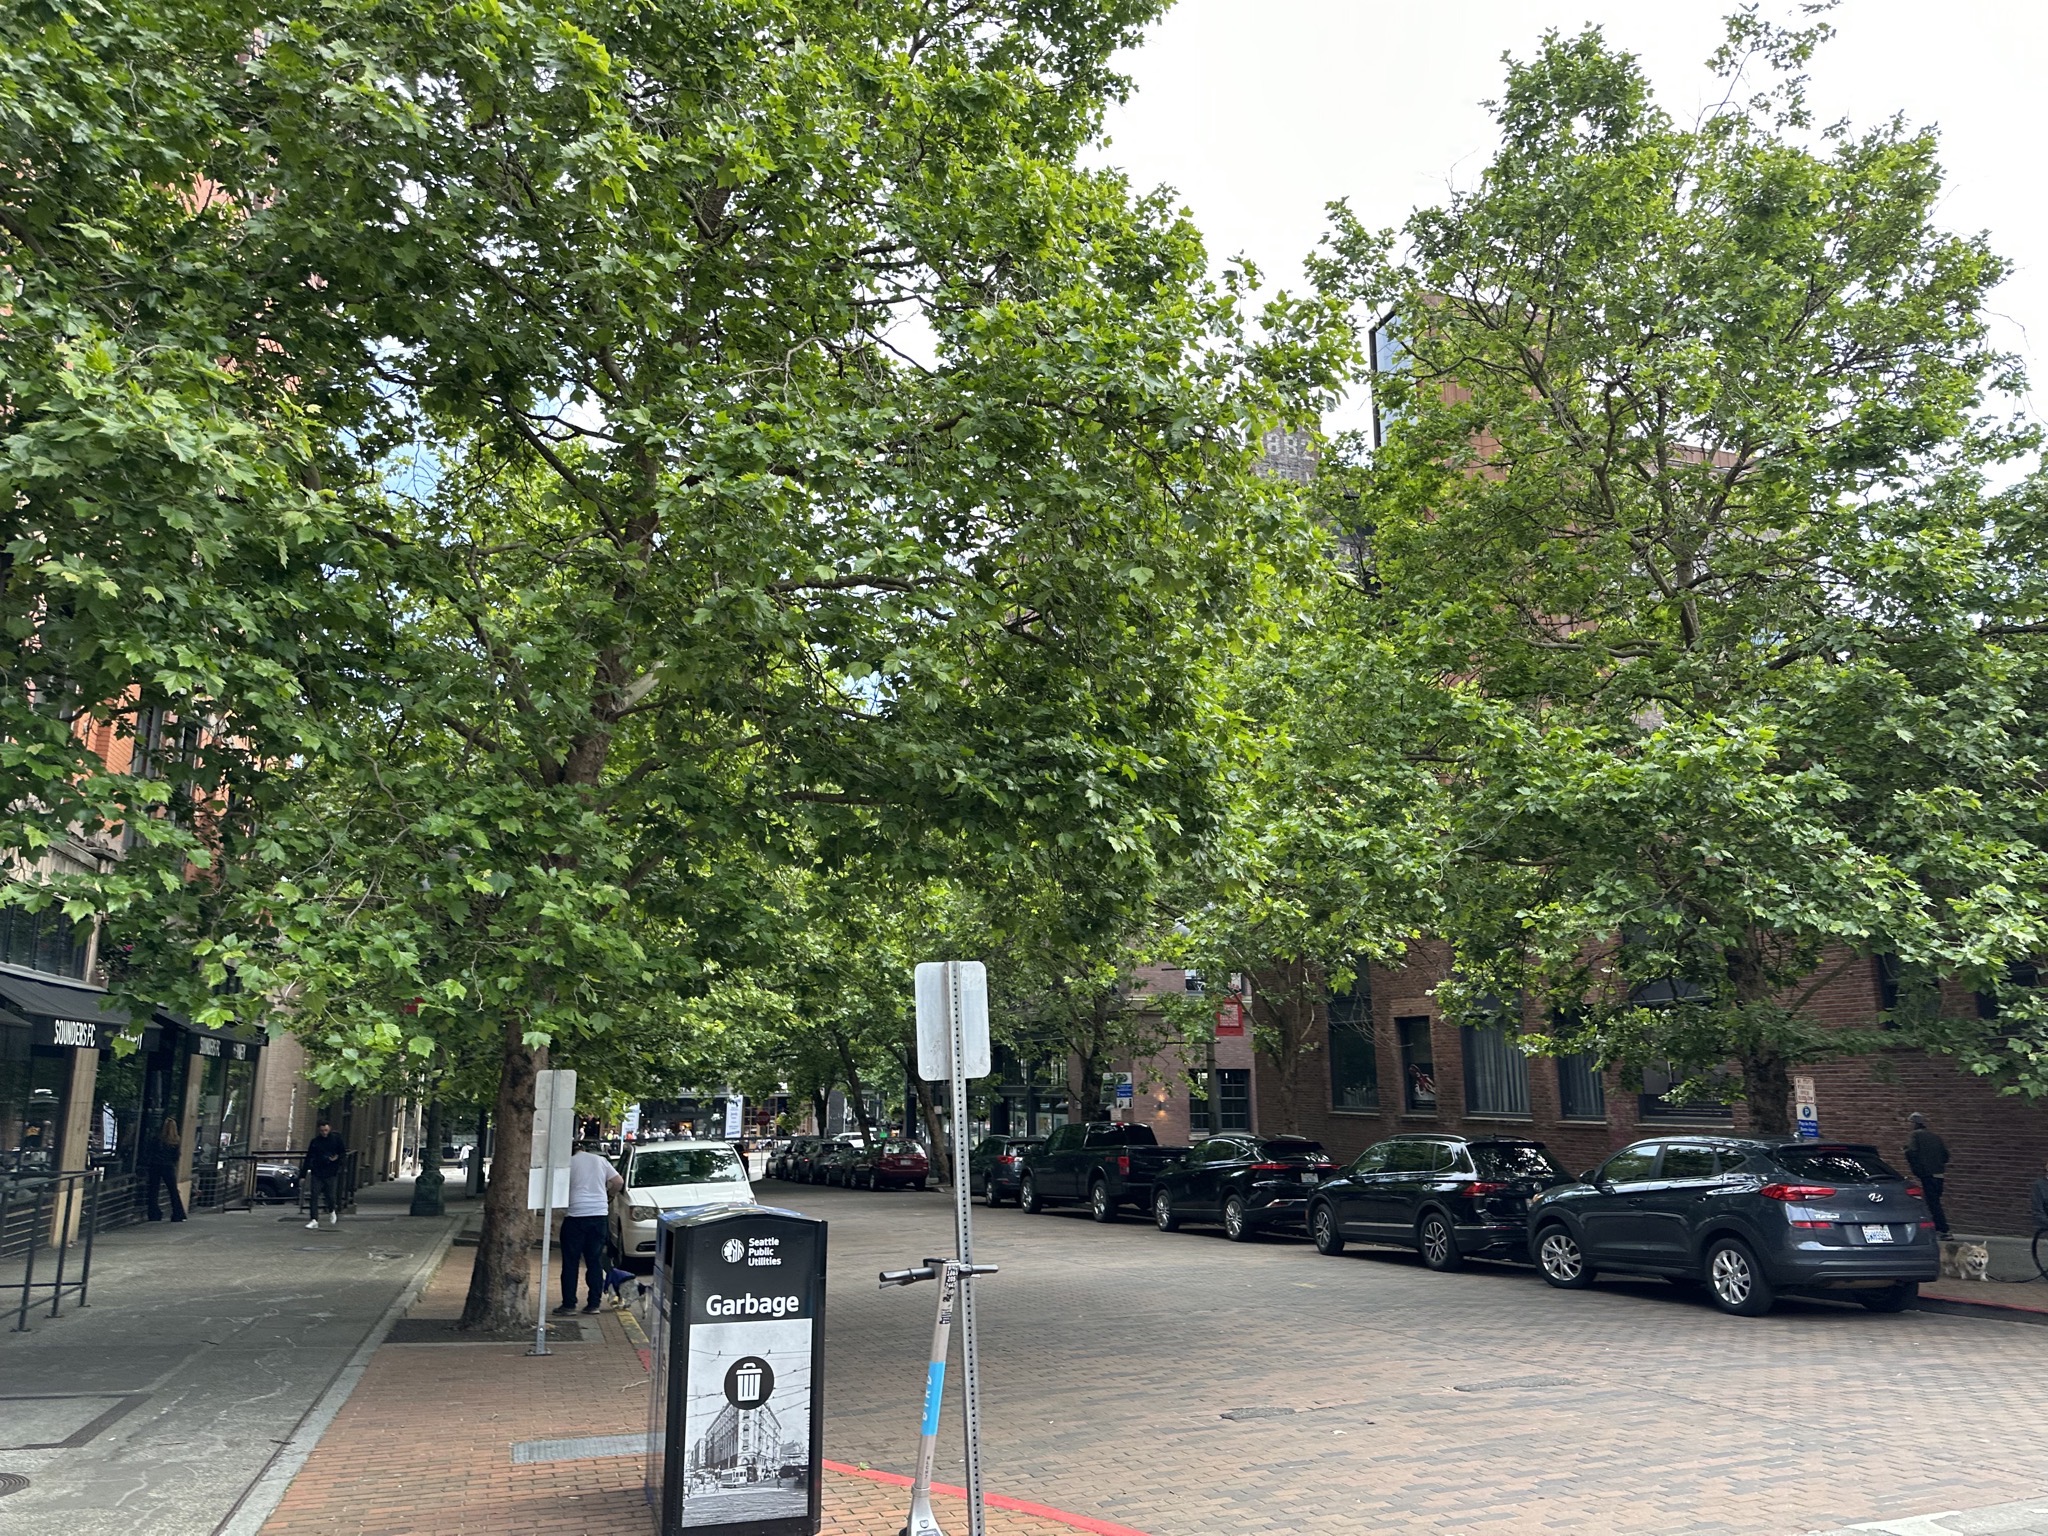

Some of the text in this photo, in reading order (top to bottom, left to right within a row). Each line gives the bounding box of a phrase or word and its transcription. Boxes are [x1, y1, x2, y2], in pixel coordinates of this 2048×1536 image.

[54, 1019, 88, 1047] SOUNDERS
[86, 1023, 97, 1047] FC
[748, 1237, 780, 1247] Seattle
[748, 1247, 774, 1257] Public
[747, 1256, 782, 1267] Utilities
[705, 1292, 800, 1318] Garbage
